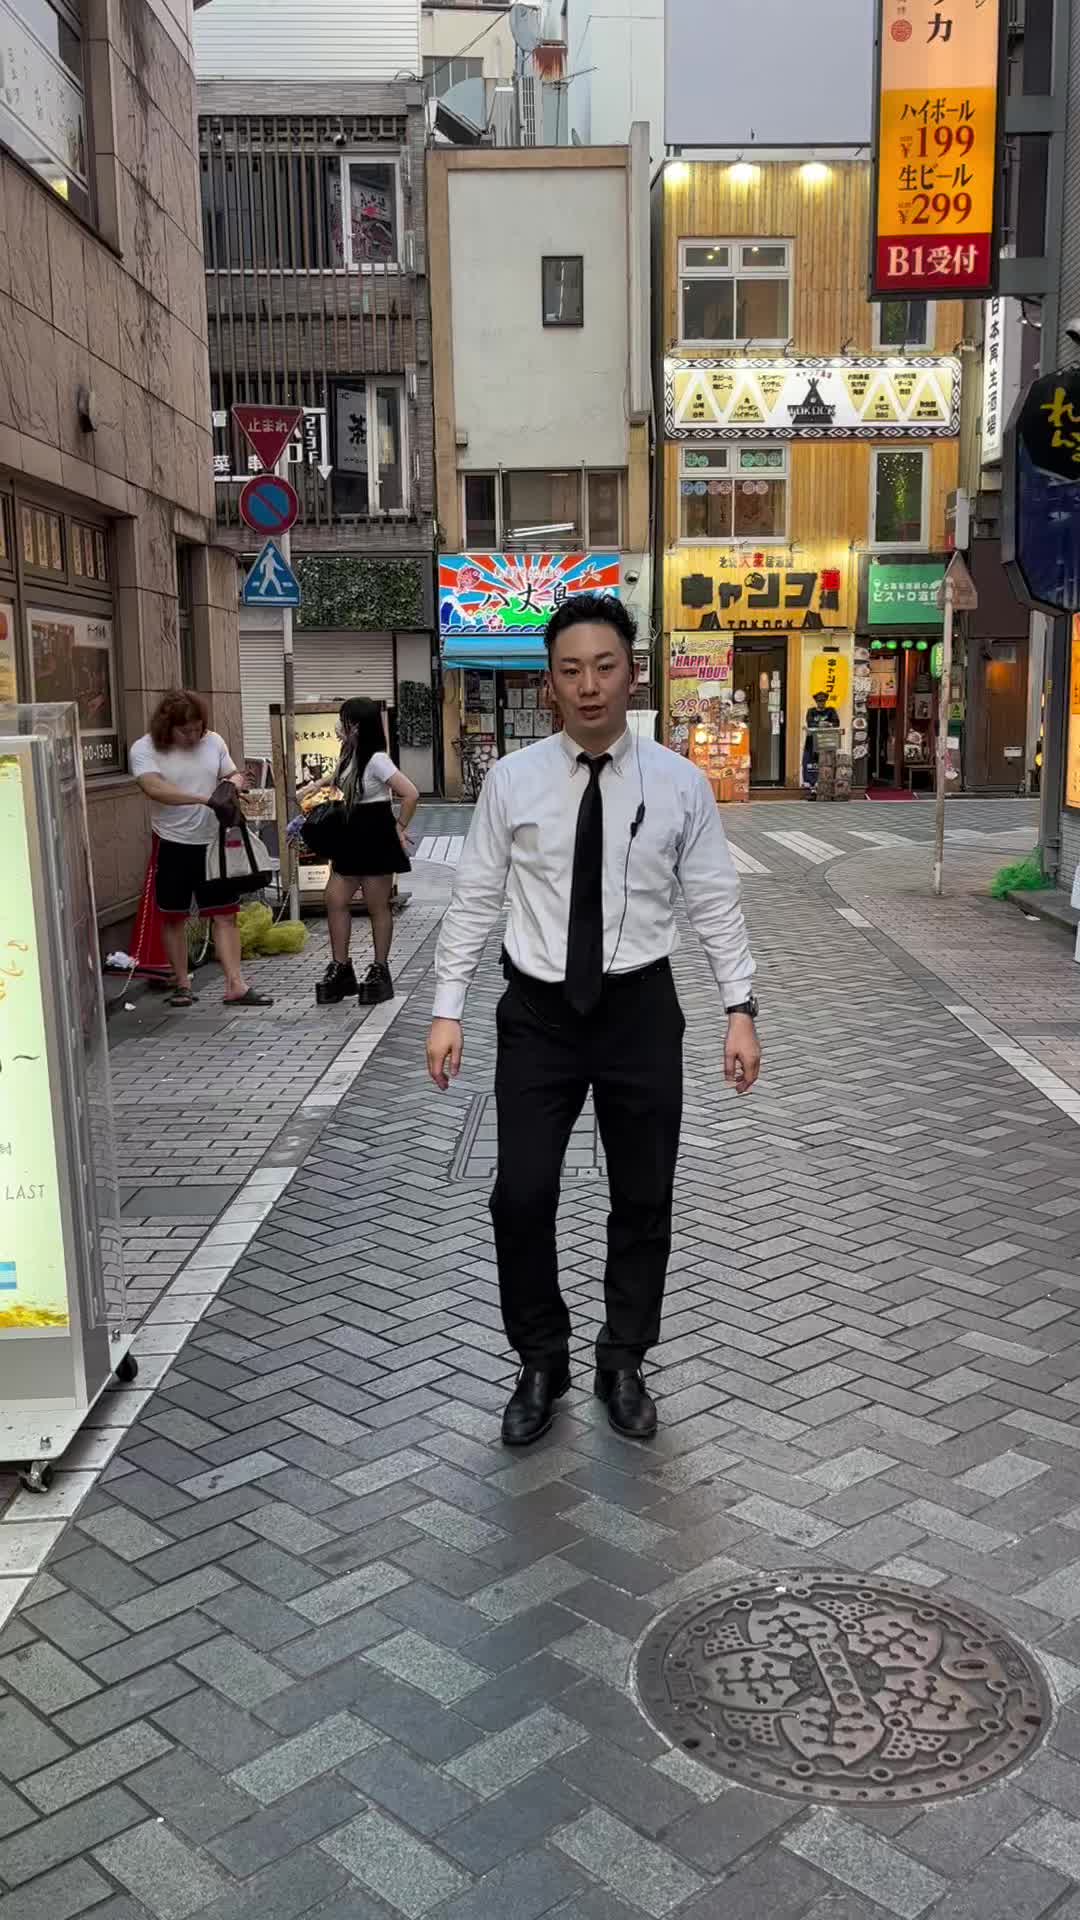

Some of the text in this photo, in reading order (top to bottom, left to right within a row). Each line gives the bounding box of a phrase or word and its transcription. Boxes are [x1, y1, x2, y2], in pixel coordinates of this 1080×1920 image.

[900, 98, 976, 125] ハイボール
[898, 163, 974, 192] 生ビール
[887, 244, 979, 277] B1受付
[247, 417, 289, 433] 止まれ
[675, 654, 711, 668] HAPPY
[697, 666, 729, 680] HOUR
[6, 1184, 46, 1201] LAST
